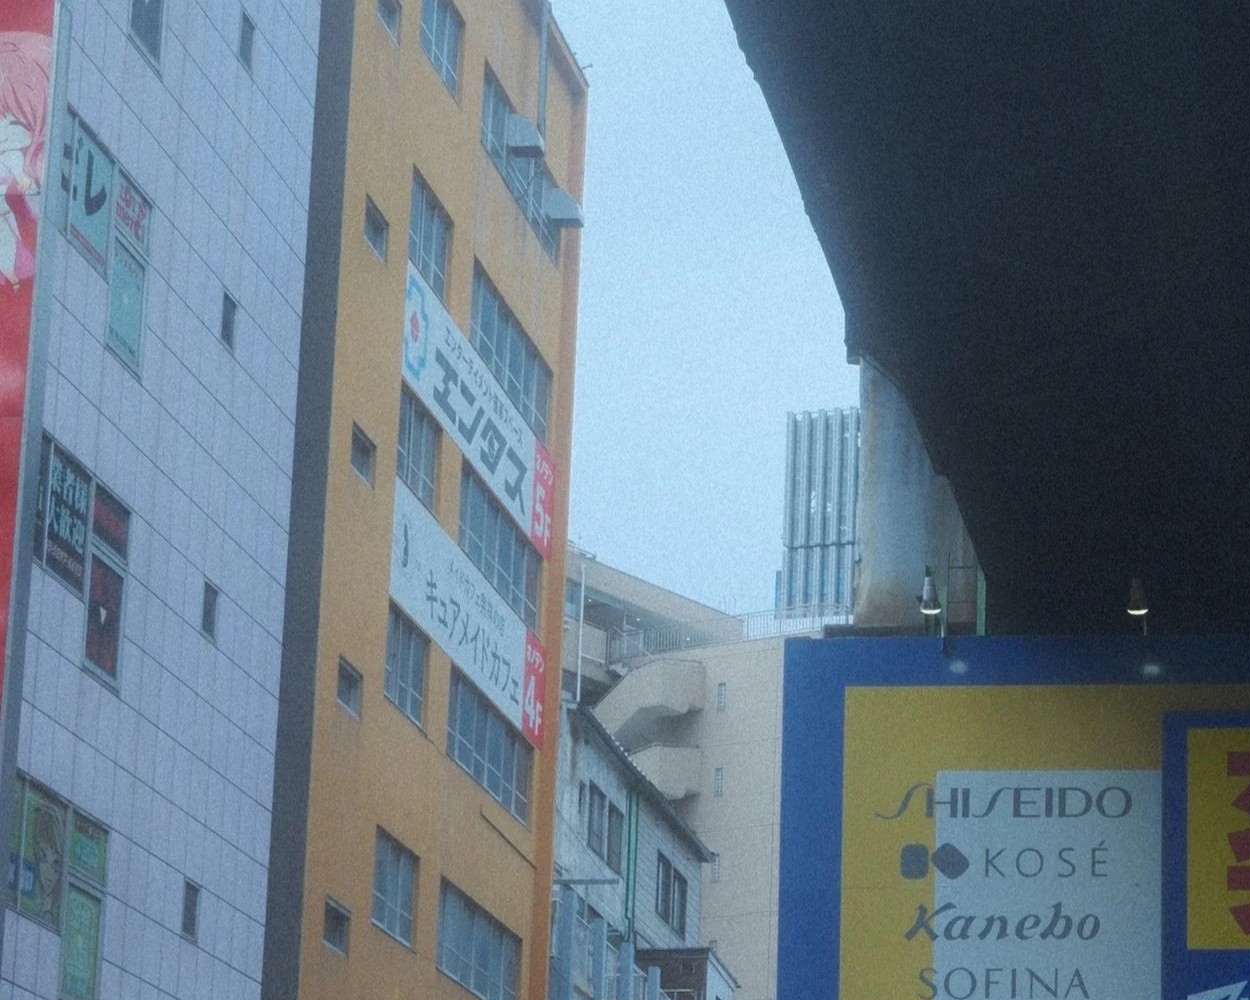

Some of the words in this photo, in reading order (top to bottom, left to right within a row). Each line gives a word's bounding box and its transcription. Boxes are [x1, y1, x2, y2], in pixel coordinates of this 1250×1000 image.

[533, 485, 551, 547] 5F
[424, 571, 520, 705] キュアメイドカフェ
[523, 676, 543, 737] 4F
[875, 782, 1133, 819] SHISEIDO
[985, 841, 1109, 879] KOSÉ
[904, 902, 1102, 943] Kanebo
[918, 967, 1091, 1000] SOFINA
